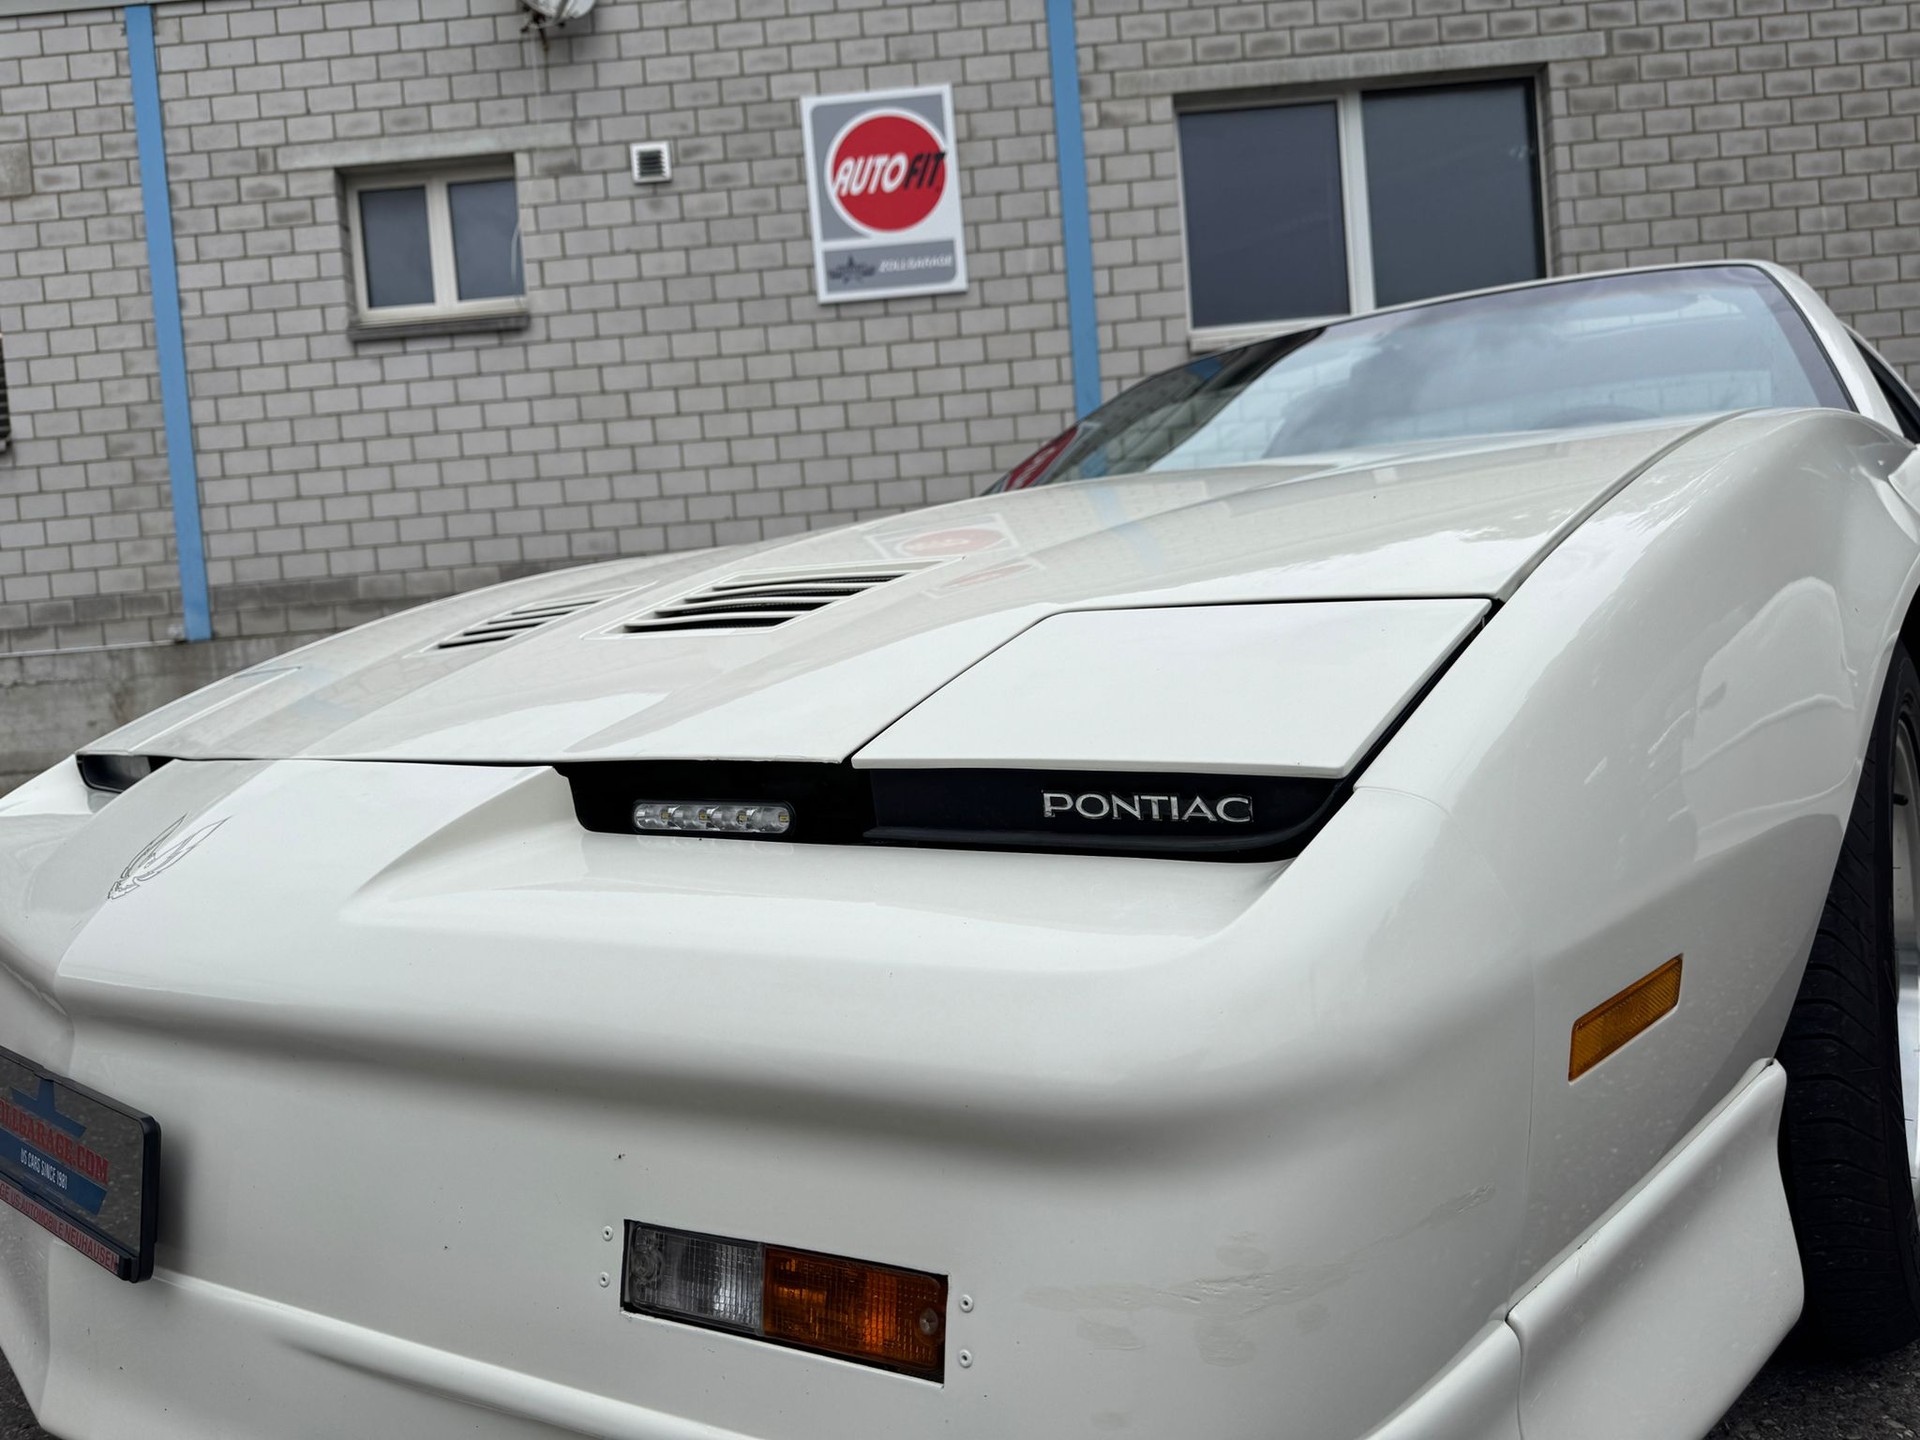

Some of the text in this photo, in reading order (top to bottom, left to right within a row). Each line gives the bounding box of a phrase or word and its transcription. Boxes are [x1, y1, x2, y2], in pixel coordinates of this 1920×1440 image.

[834, 152, 947, 197] AUTOFIT
[1042, 791, 1254, 822] PONTIAC
[20, 1147, 27, 1165] US
[27, 1152, 40, 1174] CARS
[41, 1160, 56, 1183] SINCE
[65, 1224, 118, 1273] NEUHAUSEN
